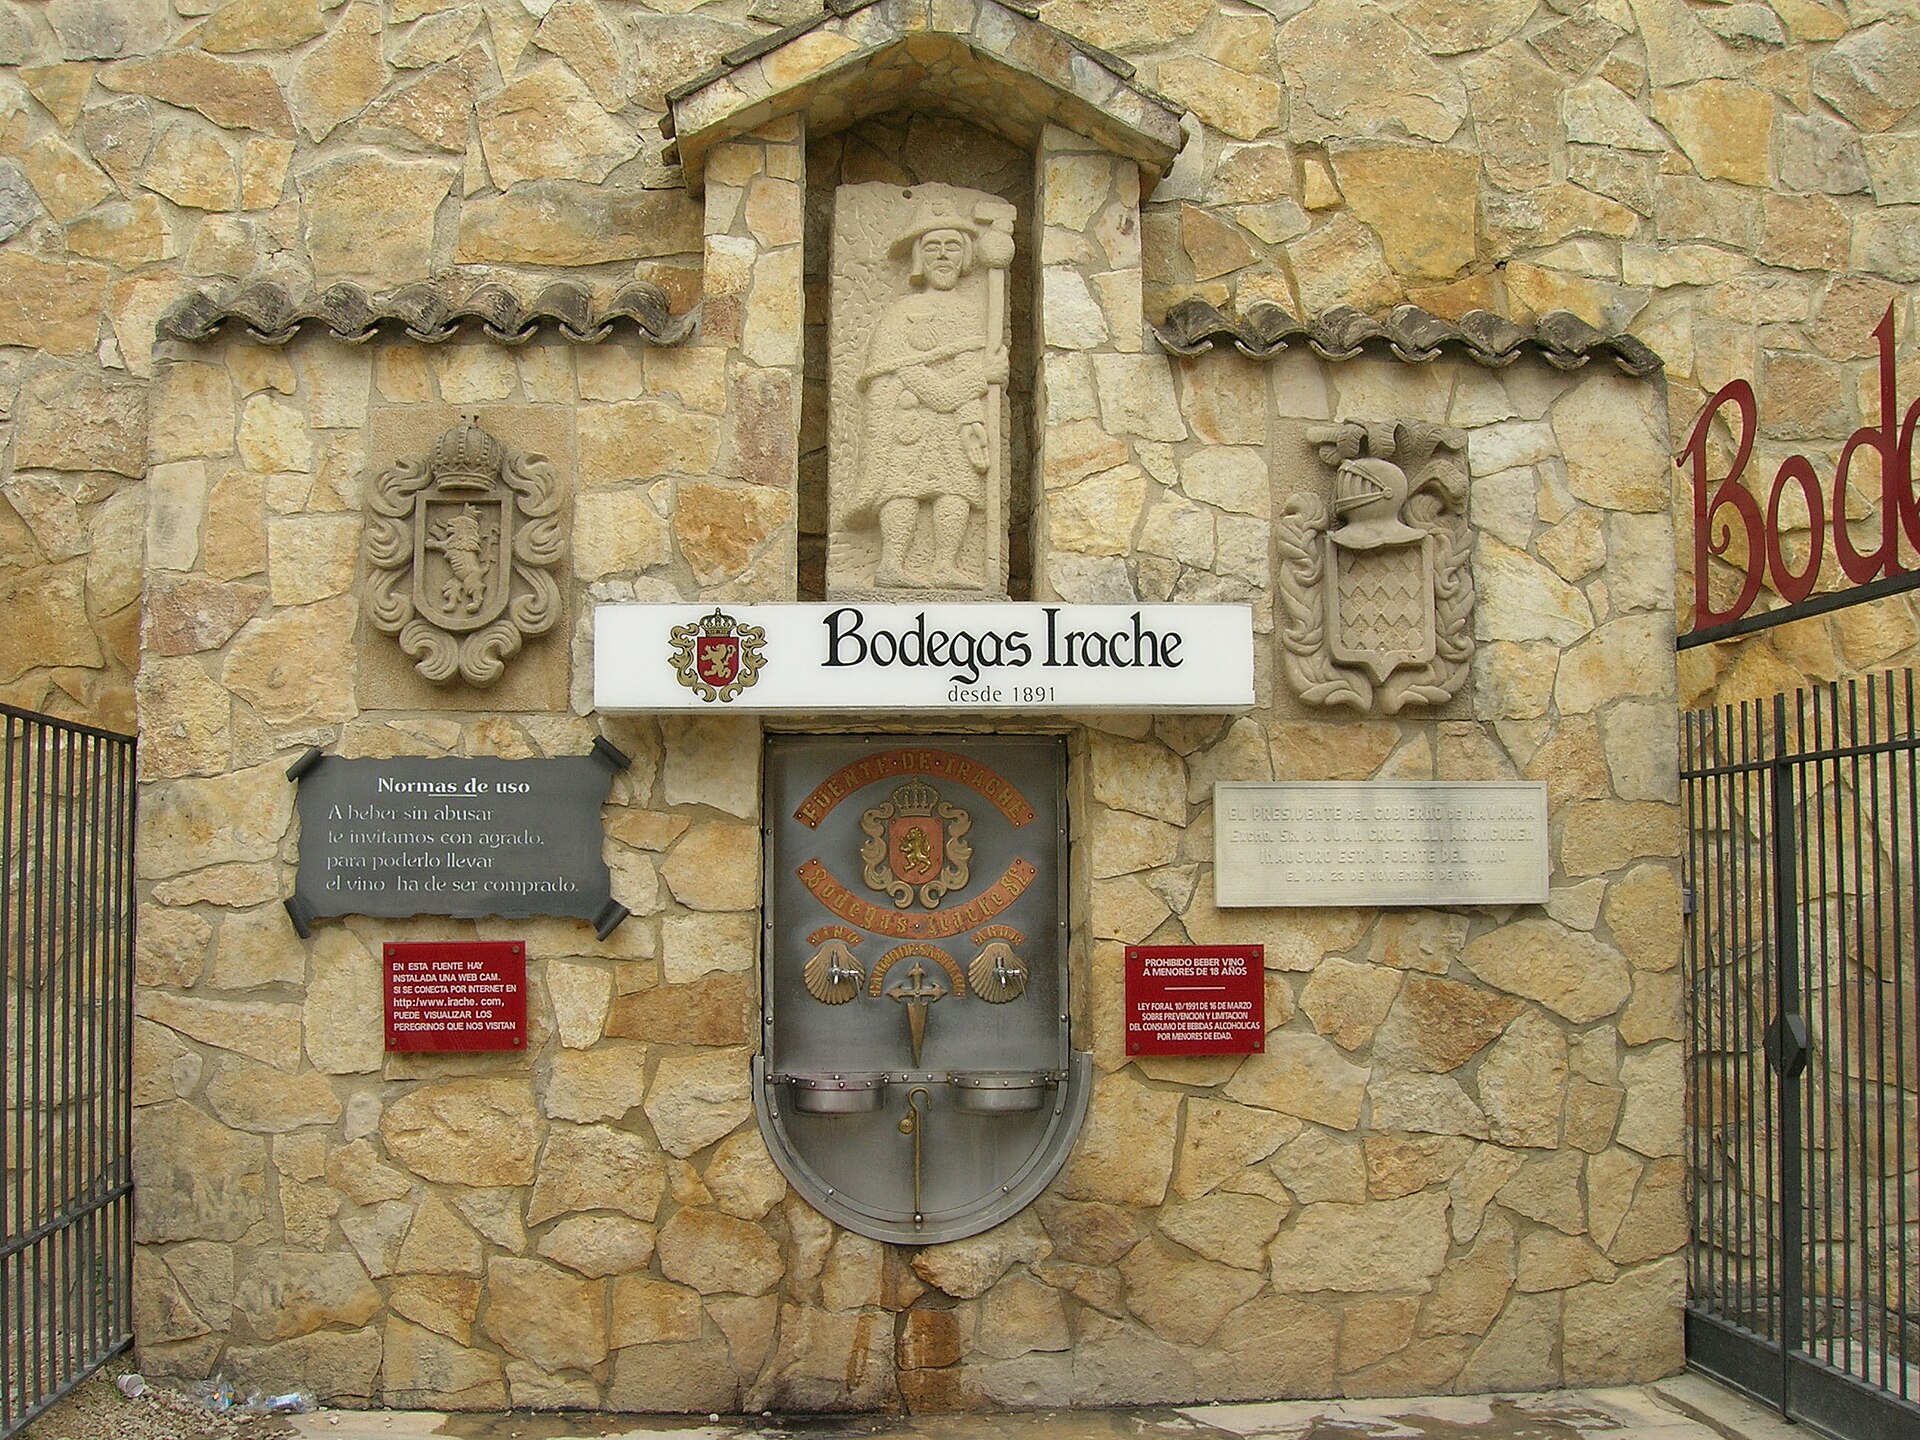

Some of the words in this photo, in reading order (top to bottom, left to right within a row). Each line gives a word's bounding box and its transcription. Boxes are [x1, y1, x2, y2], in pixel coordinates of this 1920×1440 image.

[821, 607, 1032, 684] Bodegas
[1042, 607, 1183, 667] Irache
[948, 685, 1002, 702] desde
[1012, 686, 1055, 702] 1891
[378, 778, 456, 793] Normas
[464, 778, 488, 793] de
[496, 782, 530, 793] uso
[803, 757, 889, 820] FUENTE
[902, 753, 931, 770] DE
[944, 758, 1026, 818] IRACHE
[328, 806, 342, 820] A
[349, 805, 398, 820] beber
[404, 806, 428, 820] sin
[434, 805, 495, 820] abusar
[328, 830, 343, 843] te
[350, 830, 435, 844] invitamos
[440, 833, 472, 844] con
[479, 830, 545, 848] agrado.
[327, 856, 366, 871] para
[373, 853, 440, 871] poderlo
[447, 853, 495, 868] llevar
[326, 876, 340, 891] el
[346, 878, 385, 891] vino
[397, 876, 418, 892] ha
[425, 876, 447, 892] de
[452, 879, 478, 892] ser
[484, 876, 579, 895] comprado.
[805, 868, 909, 933] Bodegas
[811, 927, 859, 942] VINO
[976, 926, 1020, 946] AGUA
[393, 963, 404, 971] EN
[408, 963, 428, 971] ESTA
[432, 962, 463, 970] FUENTE
[467, 962, 483, 970] HAY
[1194, 958, 1220, 966] BEBER
[1222, 958, 1244, 966] VINO
[393, 974, 437, 982] INSTALADA
[479, 973, 501, 981] CAM.
[1143, 968, 1150, 976] A
[1152, 968, 1194, 976] MENORES
[1196, 967, 1207, 975] DE
[1221, 966, 1247, 975] AÑOS
[394, 986, 401, 994] SI
[451, 985, 466, 993] POR
[468, 985, 504, 993] INTERNET
[394, 1011, 420, 1019] PUEDE
[424, 1011, 471, 1019] VISUALIZAR
[394, 1023, 444, 1031] PEREGRINOS
[466, 1022, 483, 1030] NOS
[485, 1022, 515, 1030] VISITAN
[1130, 1023, 1141, 1031] DEL
[1187, 1022, 1213, 1030] BEBIDAS
[1214, 1022, 1260, 1030] ALCOHOLICAS
